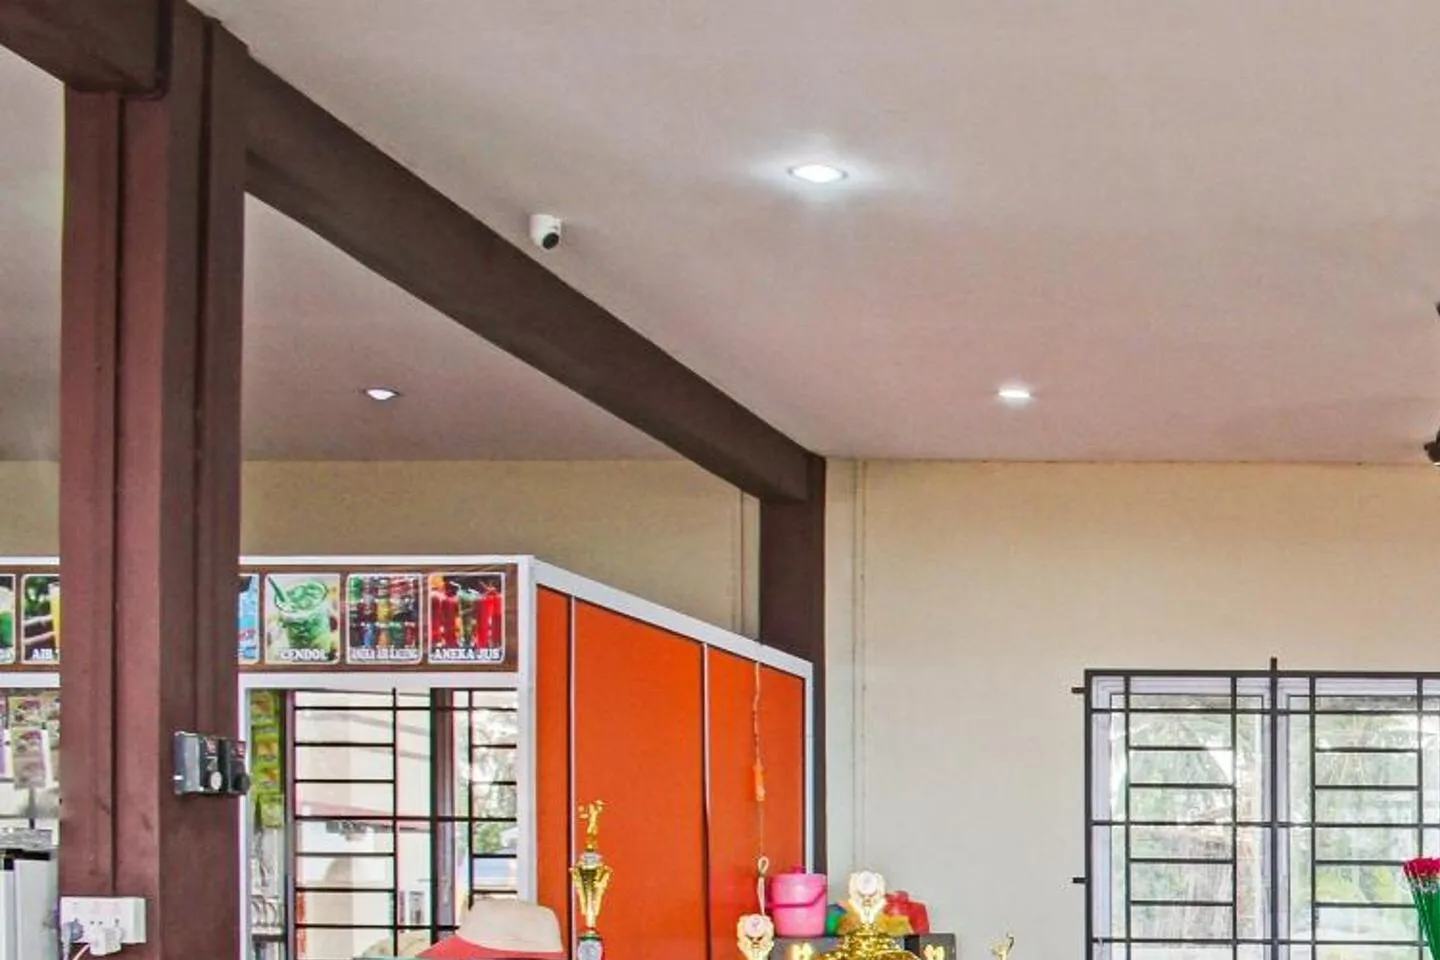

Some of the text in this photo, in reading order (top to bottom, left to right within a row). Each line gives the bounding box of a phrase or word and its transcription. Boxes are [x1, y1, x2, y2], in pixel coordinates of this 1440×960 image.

[280, 648, 329, 660] CENDOL
[432, 648, 475, 661] ANEKA
[476, 648, 500, 661] JUS
